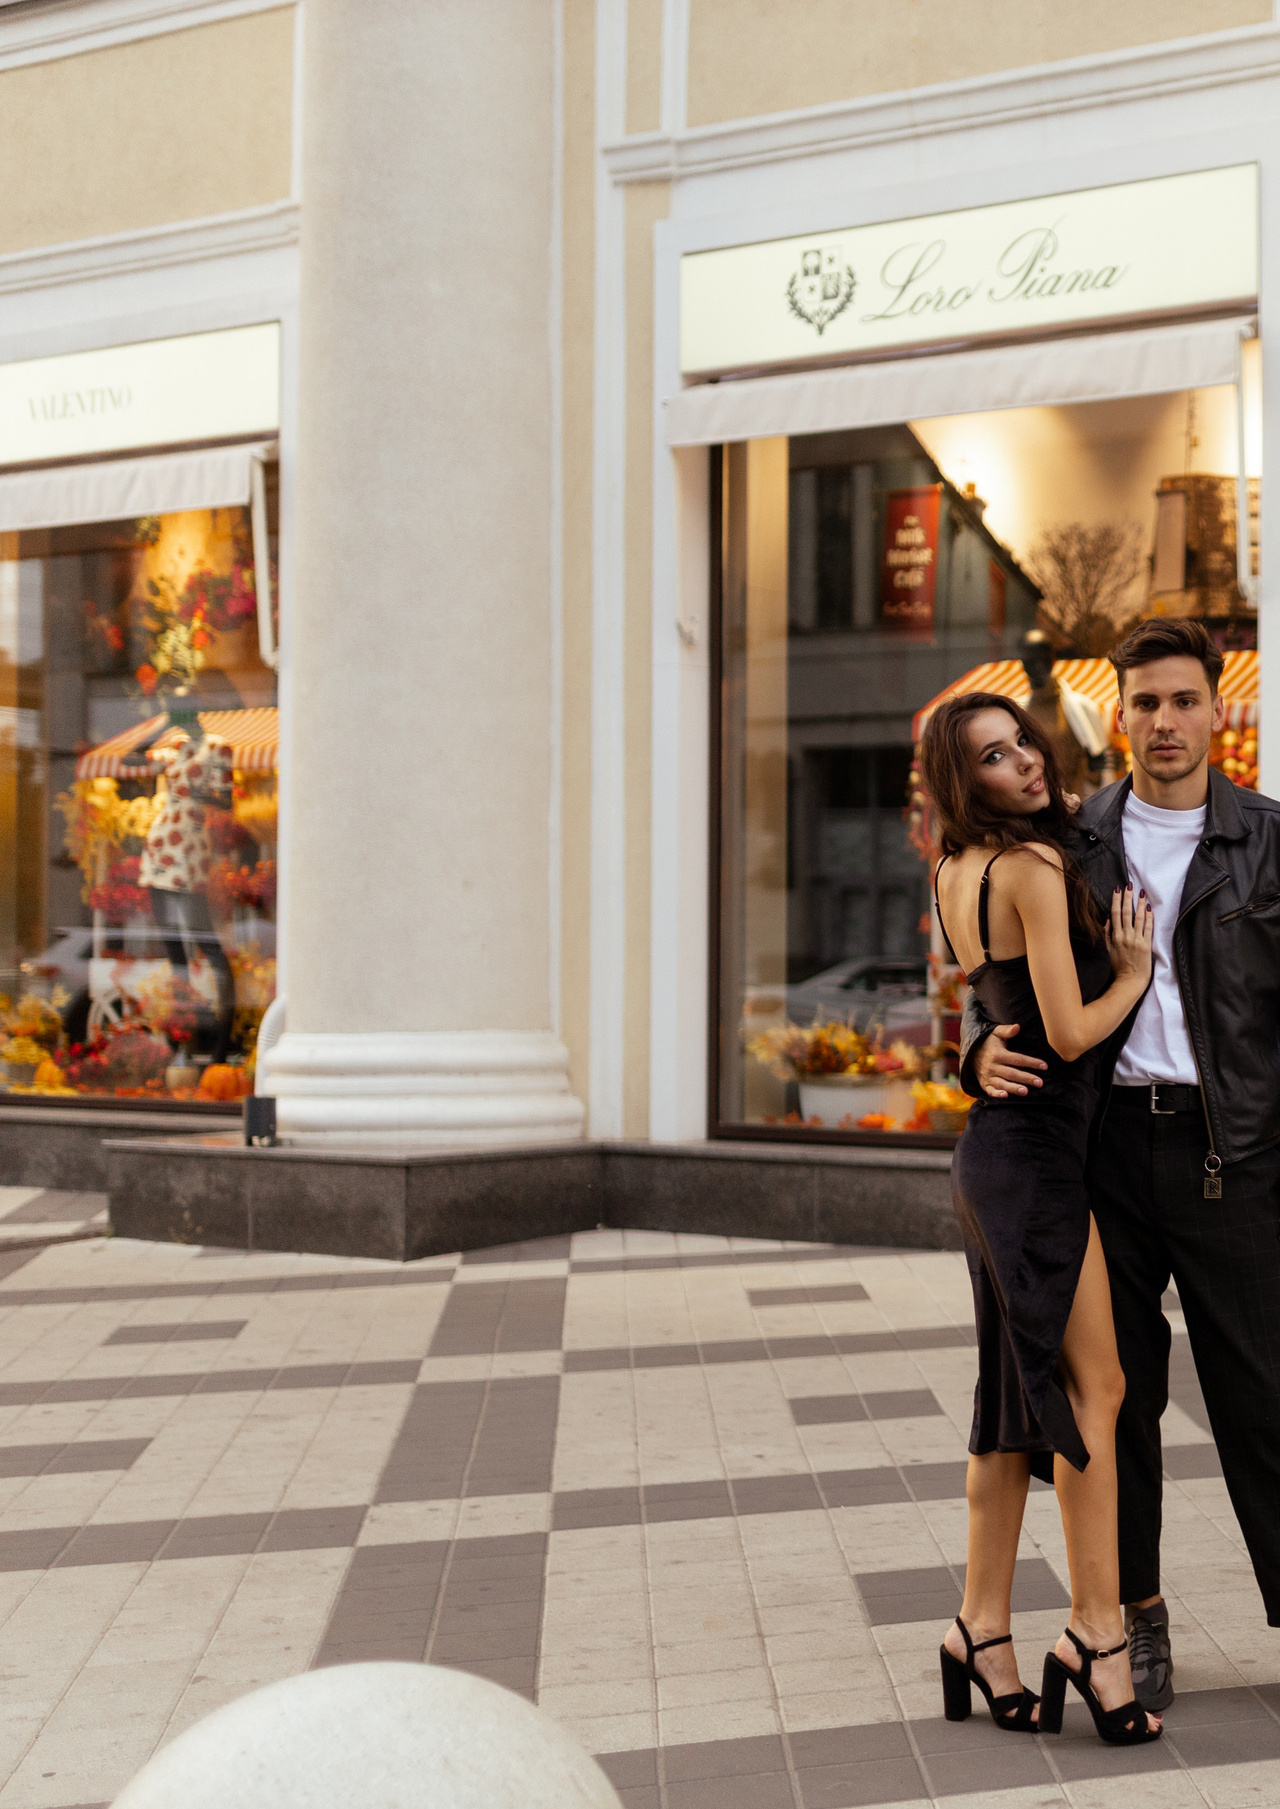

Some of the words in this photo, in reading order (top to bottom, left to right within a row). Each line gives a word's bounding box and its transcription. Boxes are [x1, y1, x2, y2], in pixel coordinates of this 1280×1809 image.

[860, 239, 982, 322] Loro
[987, 214, 1130, 302] Piana
[27, 384, 132, 421] VALENTINO
